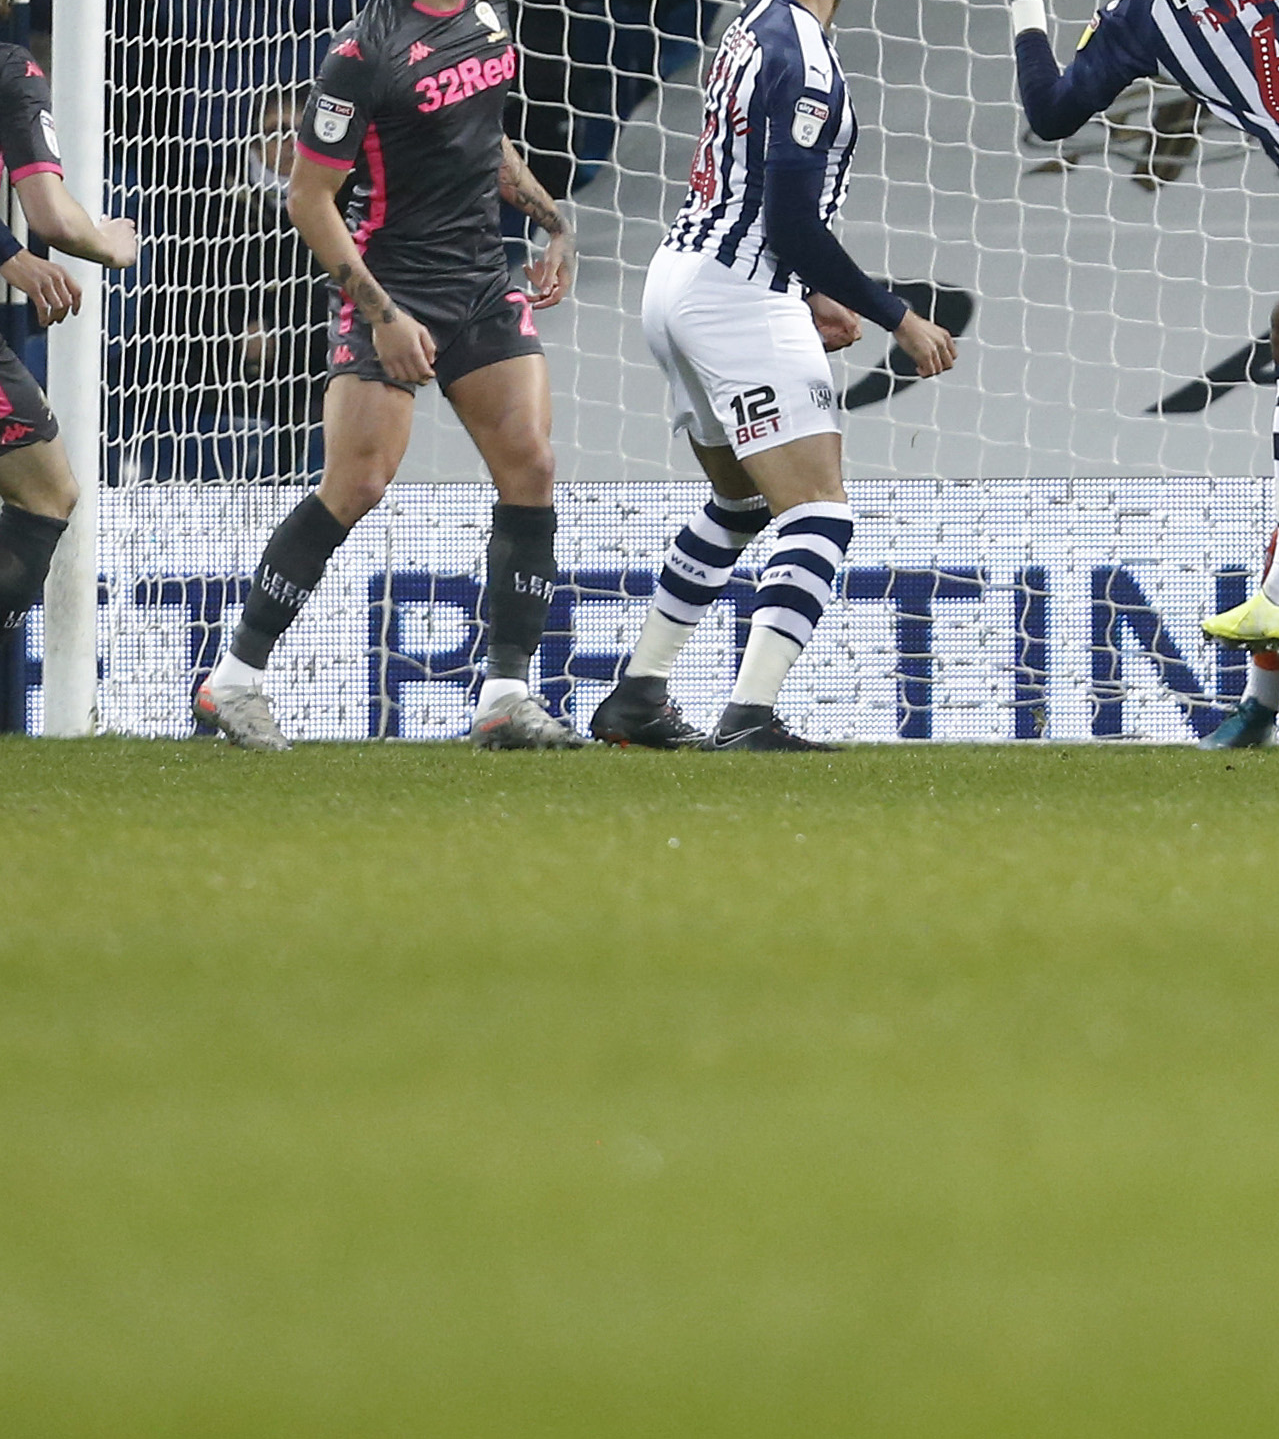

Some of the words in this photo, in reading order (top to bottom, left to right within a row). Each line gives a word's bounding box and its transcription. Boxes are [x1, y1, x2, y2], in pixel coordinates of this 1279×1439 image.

[415, 45, 516, 114] 32Red
[798, 102, 813, 115] sky
[813, 106, 828, 120] bet
[729, 384, 780, 426] 12
[735, 414, 782, 446] BET
[670, 552, 707, 580] WBA
